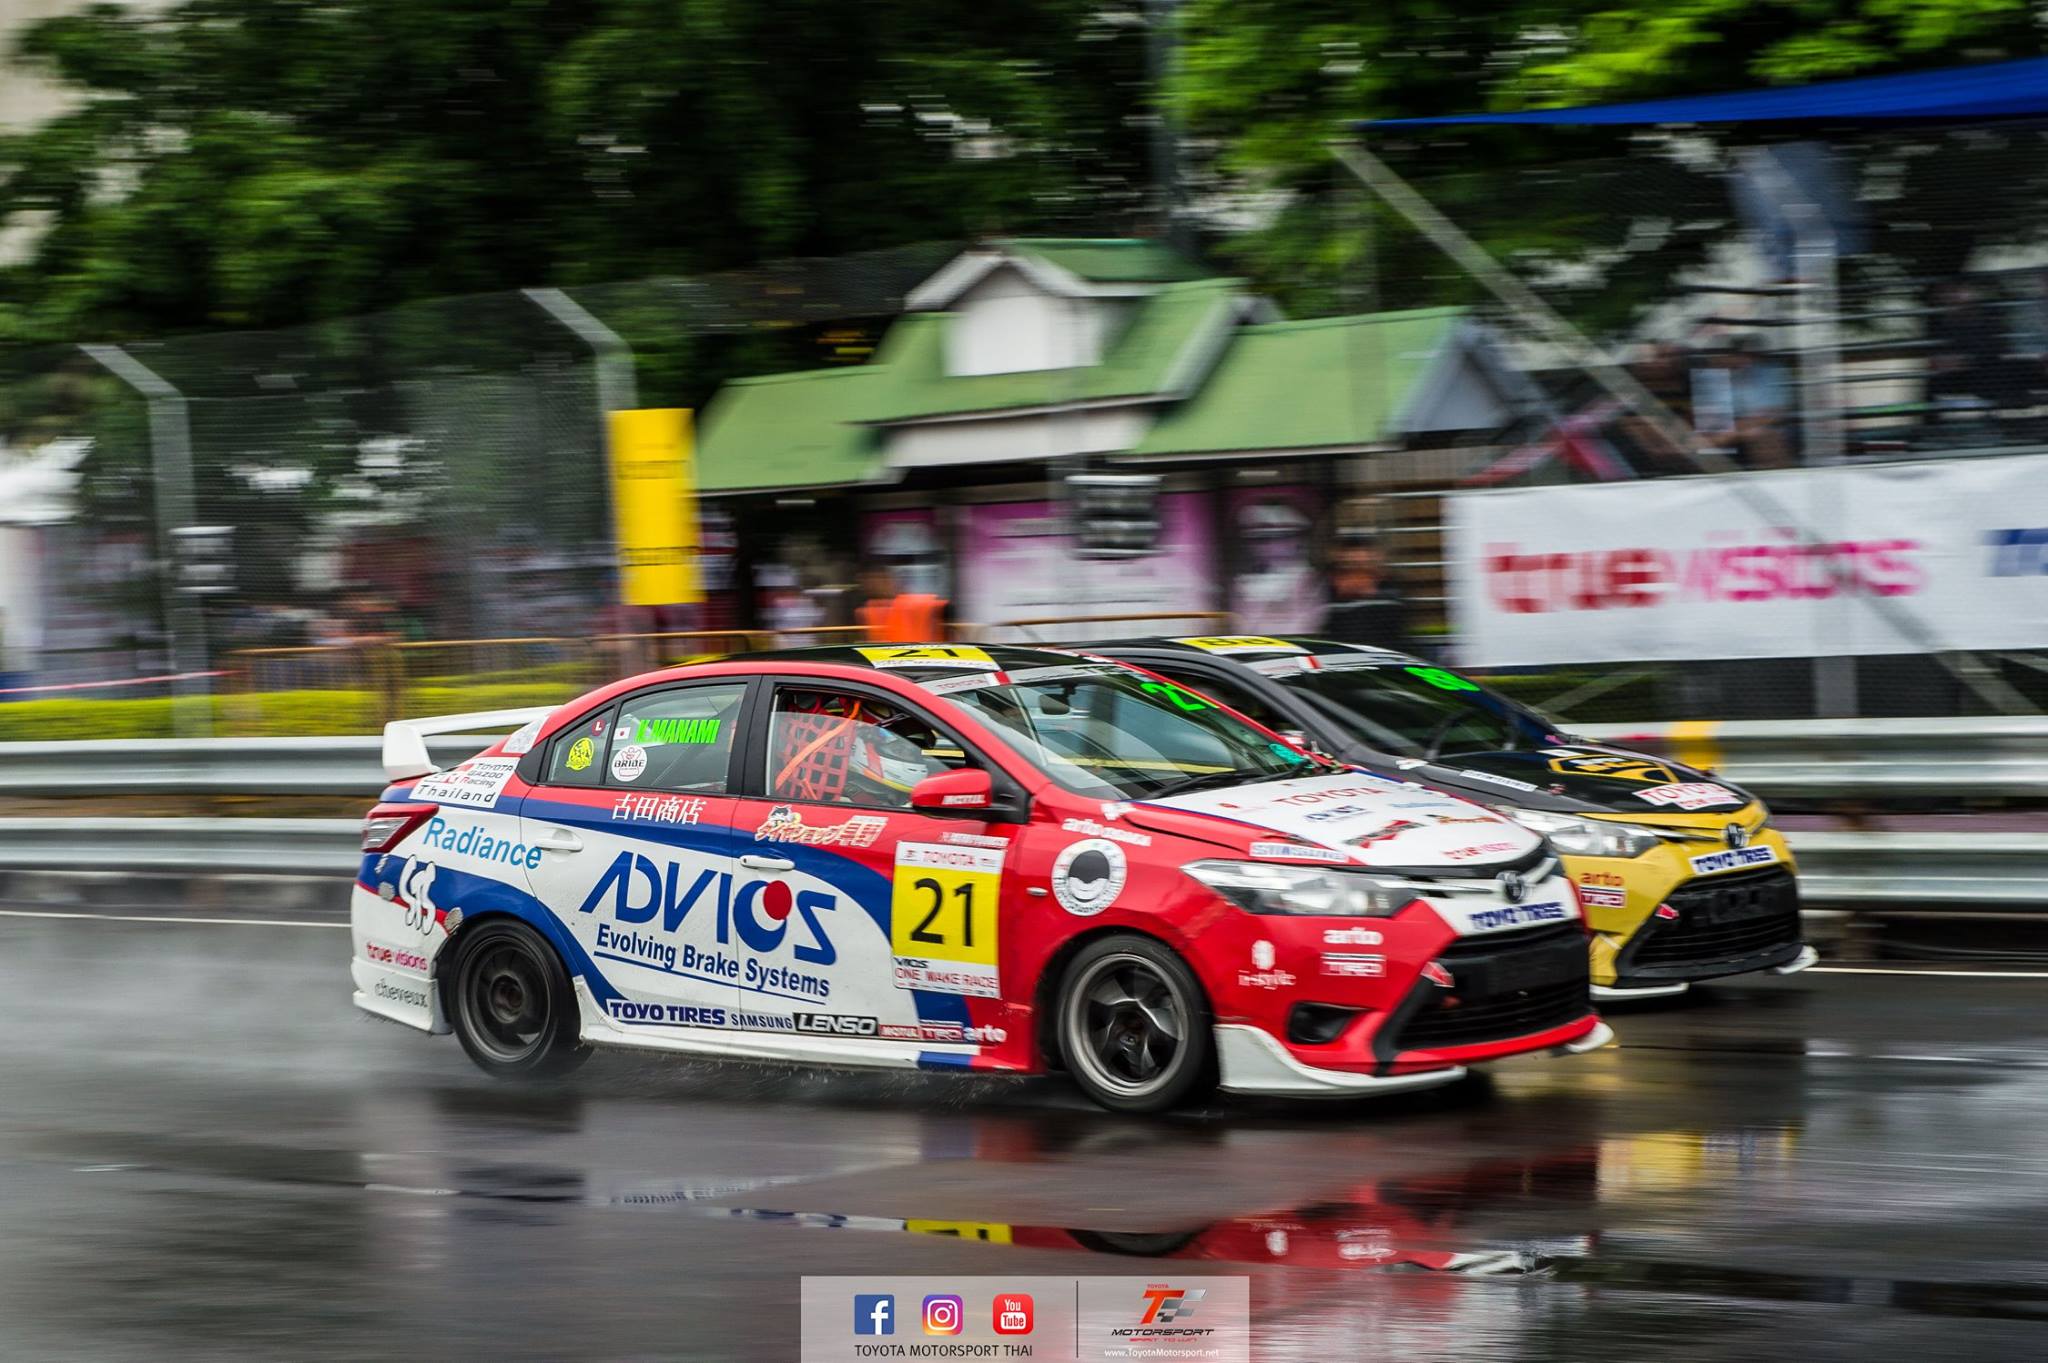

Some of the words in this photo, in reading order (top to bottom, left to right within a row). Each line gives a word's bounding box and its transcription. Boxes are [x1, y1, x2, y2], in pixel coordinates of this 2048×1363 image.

[889, 648, 959, 658] 21
[475, 762, 514, 772] TOYOTA
[614, 759, 645, 768] BRIDE
[460, 776, 496, 788] Racing
[467, 769, 504, 779] GAZOO
[417, 784, 497, 803] Thailand
[1271, 787, 1390, 806] TOYOTA
[612, 793, 707, 825] 古田商店
[423, 817, 542, 870] Radiance
[921, 849, 976, 867] TOYOTA
[1580, 871, 1625, 887] arto
[579, 849, 837, 966] ADVICS
[910, 877, 974, 948] 21
[597, 923, 677, 970] Evolving
[682, 945, 740, 979] Brake
[745, 958, 830, 998] Systems
[894, 967, 922, 981] ONE
[962, 974, 999, 989] RACE
[610, 1002, 664, 1022] TOYO
[666, 1006, 726, 1026] TIRES
[731, 1013, 794, 1030] SAMSUNG
[800, 1014, 876, 1035] LENSO
[963, 1024, 1008, 1043] arto
